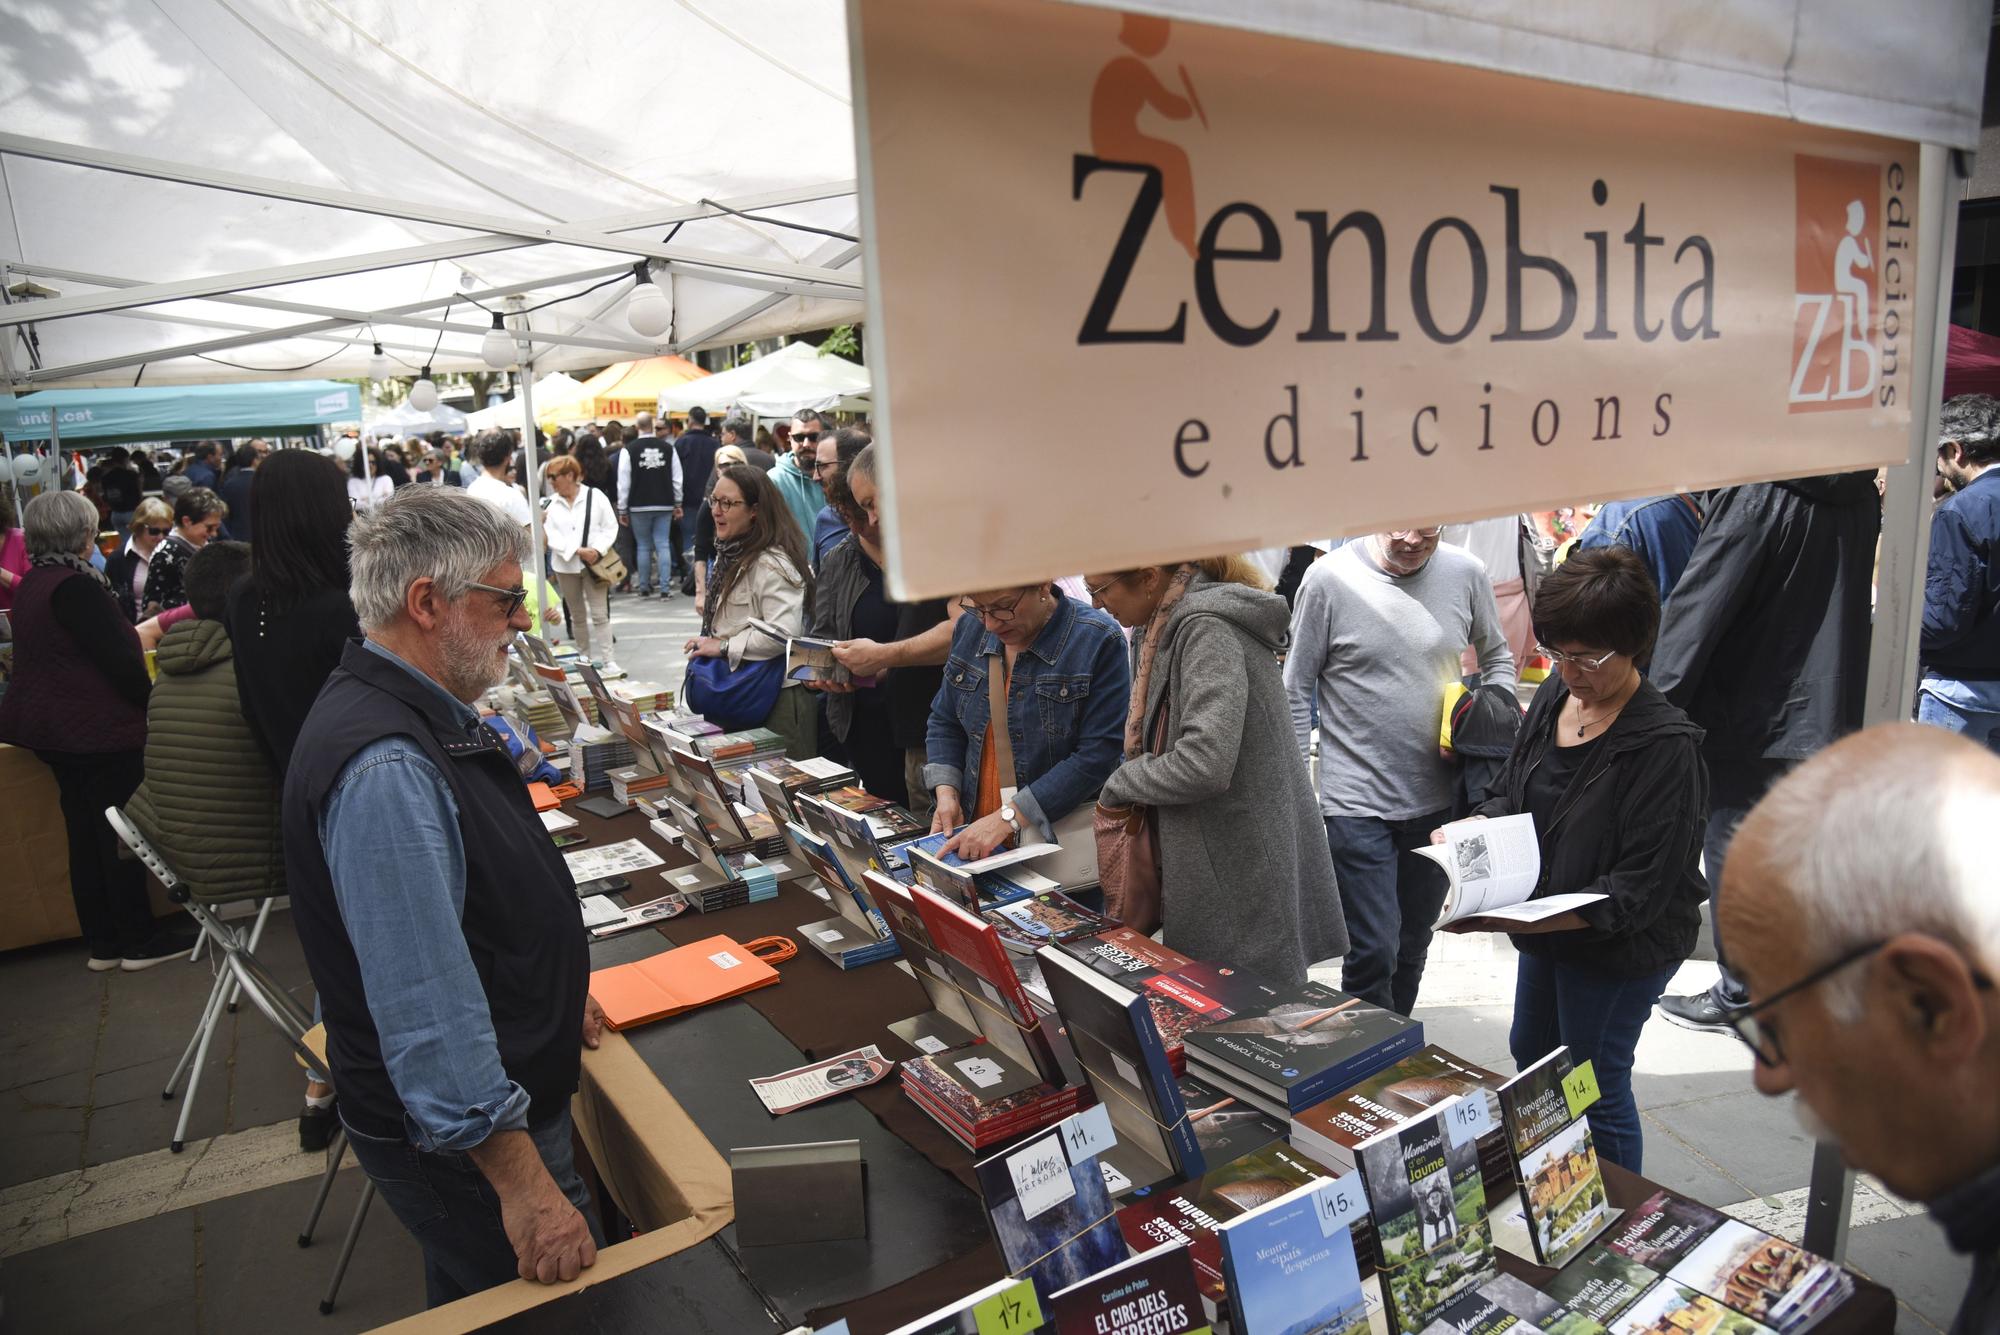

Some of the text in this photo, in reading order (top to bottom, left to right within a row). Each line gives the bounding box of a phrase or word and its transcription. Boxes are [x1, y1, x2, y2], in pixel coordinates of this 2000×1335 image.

[1073, 154, 1720, 347] Zenobita
[1879, 162, 1910, 407] edicions
[17, 408, 94, 425] unt.cat
[1173, 382, 1672, 478] edicions
[1215, 1036, 1253, 1058] TORRAS
[1252, 1053, 1282, 1070] OLIVA
[1573, 1080, 1586, 1099] 14
[1517, 1089, 1554, 1118] Topografia
[1338, 1112, 1377, 1132] masos
[1361, 1111, 1378, 1122] de
[1017, 1161, 1067, 1197] personal
[1140, 1222, 1170, 1243] ses
[1152, 1217, 1191, 1245] masos
[1179, 1219, 1195, 1231] de
[1614, 1210, 1665, 1248] Epidèmies
[1256, 1241, 1288, 1262] Mentre
[1101, 1288, 1125, 1304] Carolina
[1124, 1284, 1132, 1294] de
[1587, 1284, 1634, 1322] alamança
[999, 1297, 1021, 1329] 17
[1095, 1289, 1168, 1334] EL CIRC DELS
[1111, 1303, 1188, 1335] ERFECTES
[1425, 1305, 1445, 1322] Jaume
[1484, 1315, 1518, 1335] aume
